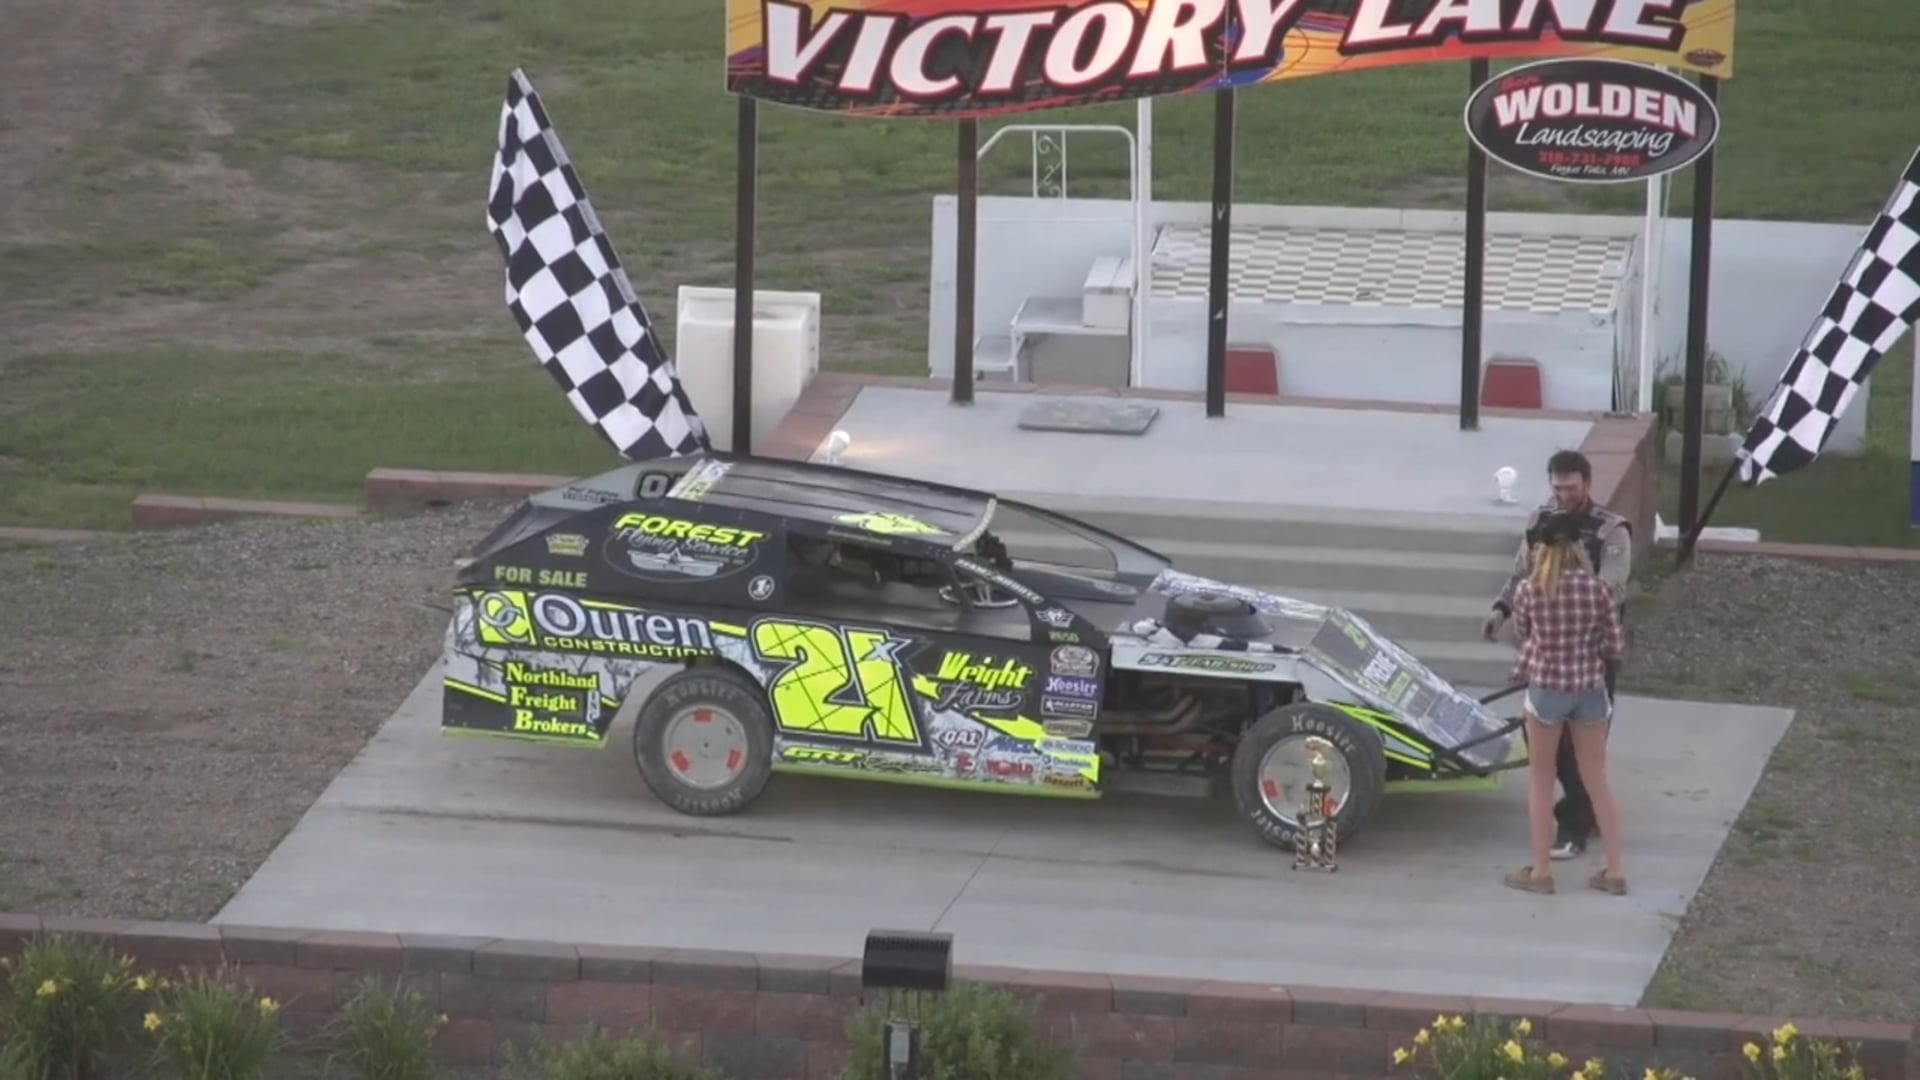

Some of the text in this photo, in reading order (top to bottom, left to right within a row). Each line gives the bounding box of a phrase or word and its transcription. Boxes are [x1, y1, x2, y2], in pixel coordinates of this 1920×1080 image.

[765, 0, 1301, 95] VICTORY
[1492, 81, 1698, 138] WOLDEN
[1514, 120, 1675, 158] Landscaping
[614, 512, 764, 548] FOREST
[494, 565, 588, 589] FOR SALE
[533, 593, 713, 648] Ouren
[506, 662, 598, 689] Northland
[1045, 677, 1097, 697] Hoosier
[510, 686, 577, 712] Freight
[932, 680, 1021, 712] Farms
[514, 709, 587, 735] Brokers
[943, 729, 979, 746] QA1
[1291, 711, 1357, 752] Hoosier
